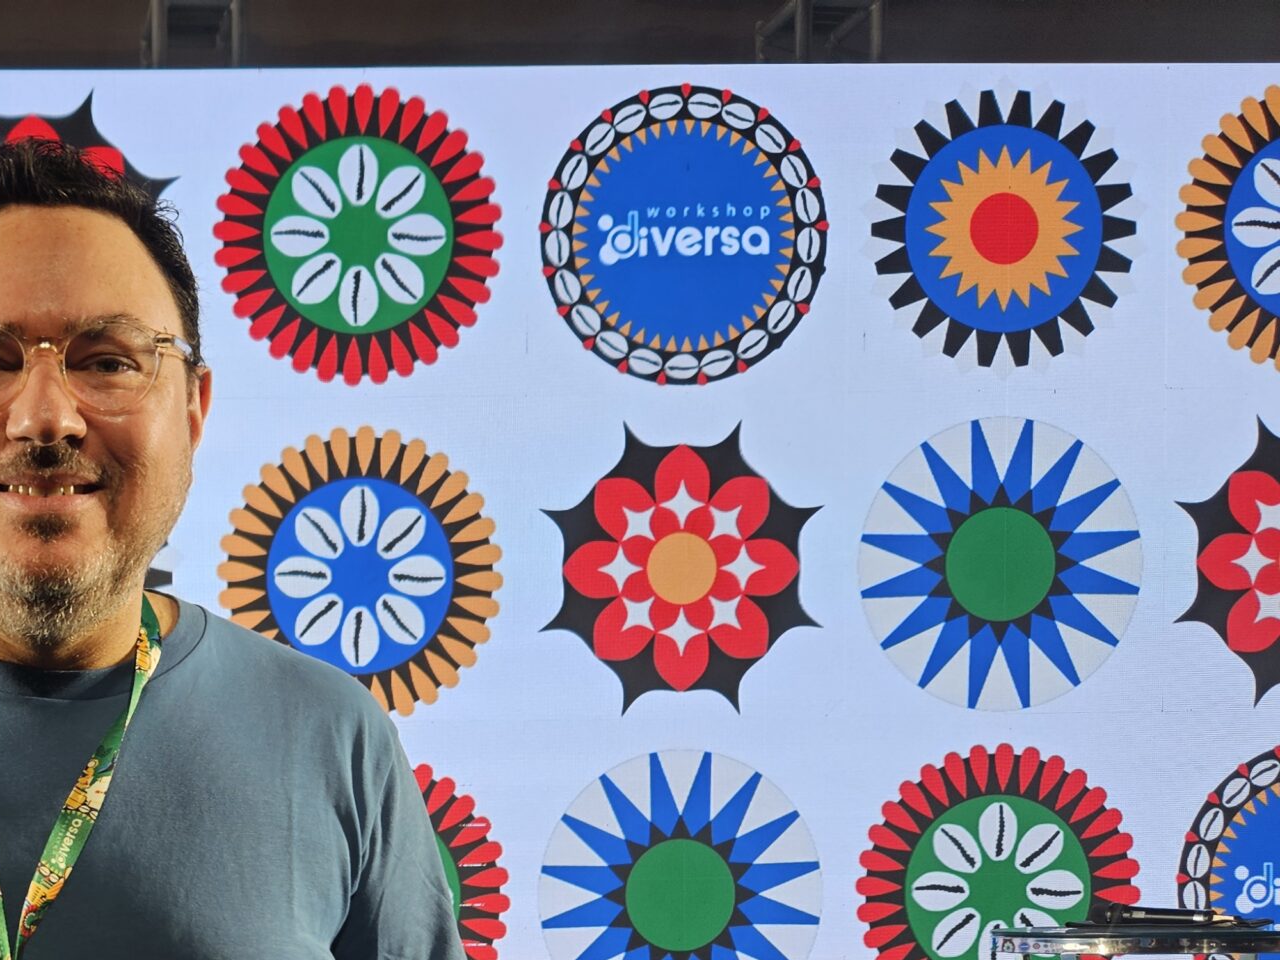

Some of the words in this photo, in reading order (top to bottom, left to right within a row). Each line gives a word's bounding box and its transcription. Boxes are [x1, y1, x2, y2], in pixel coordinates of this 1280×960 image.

[646, 203, 771, 220] workshop
[597, 210, 771, 266] diversa
[50, 818, 83, 869] diversa
